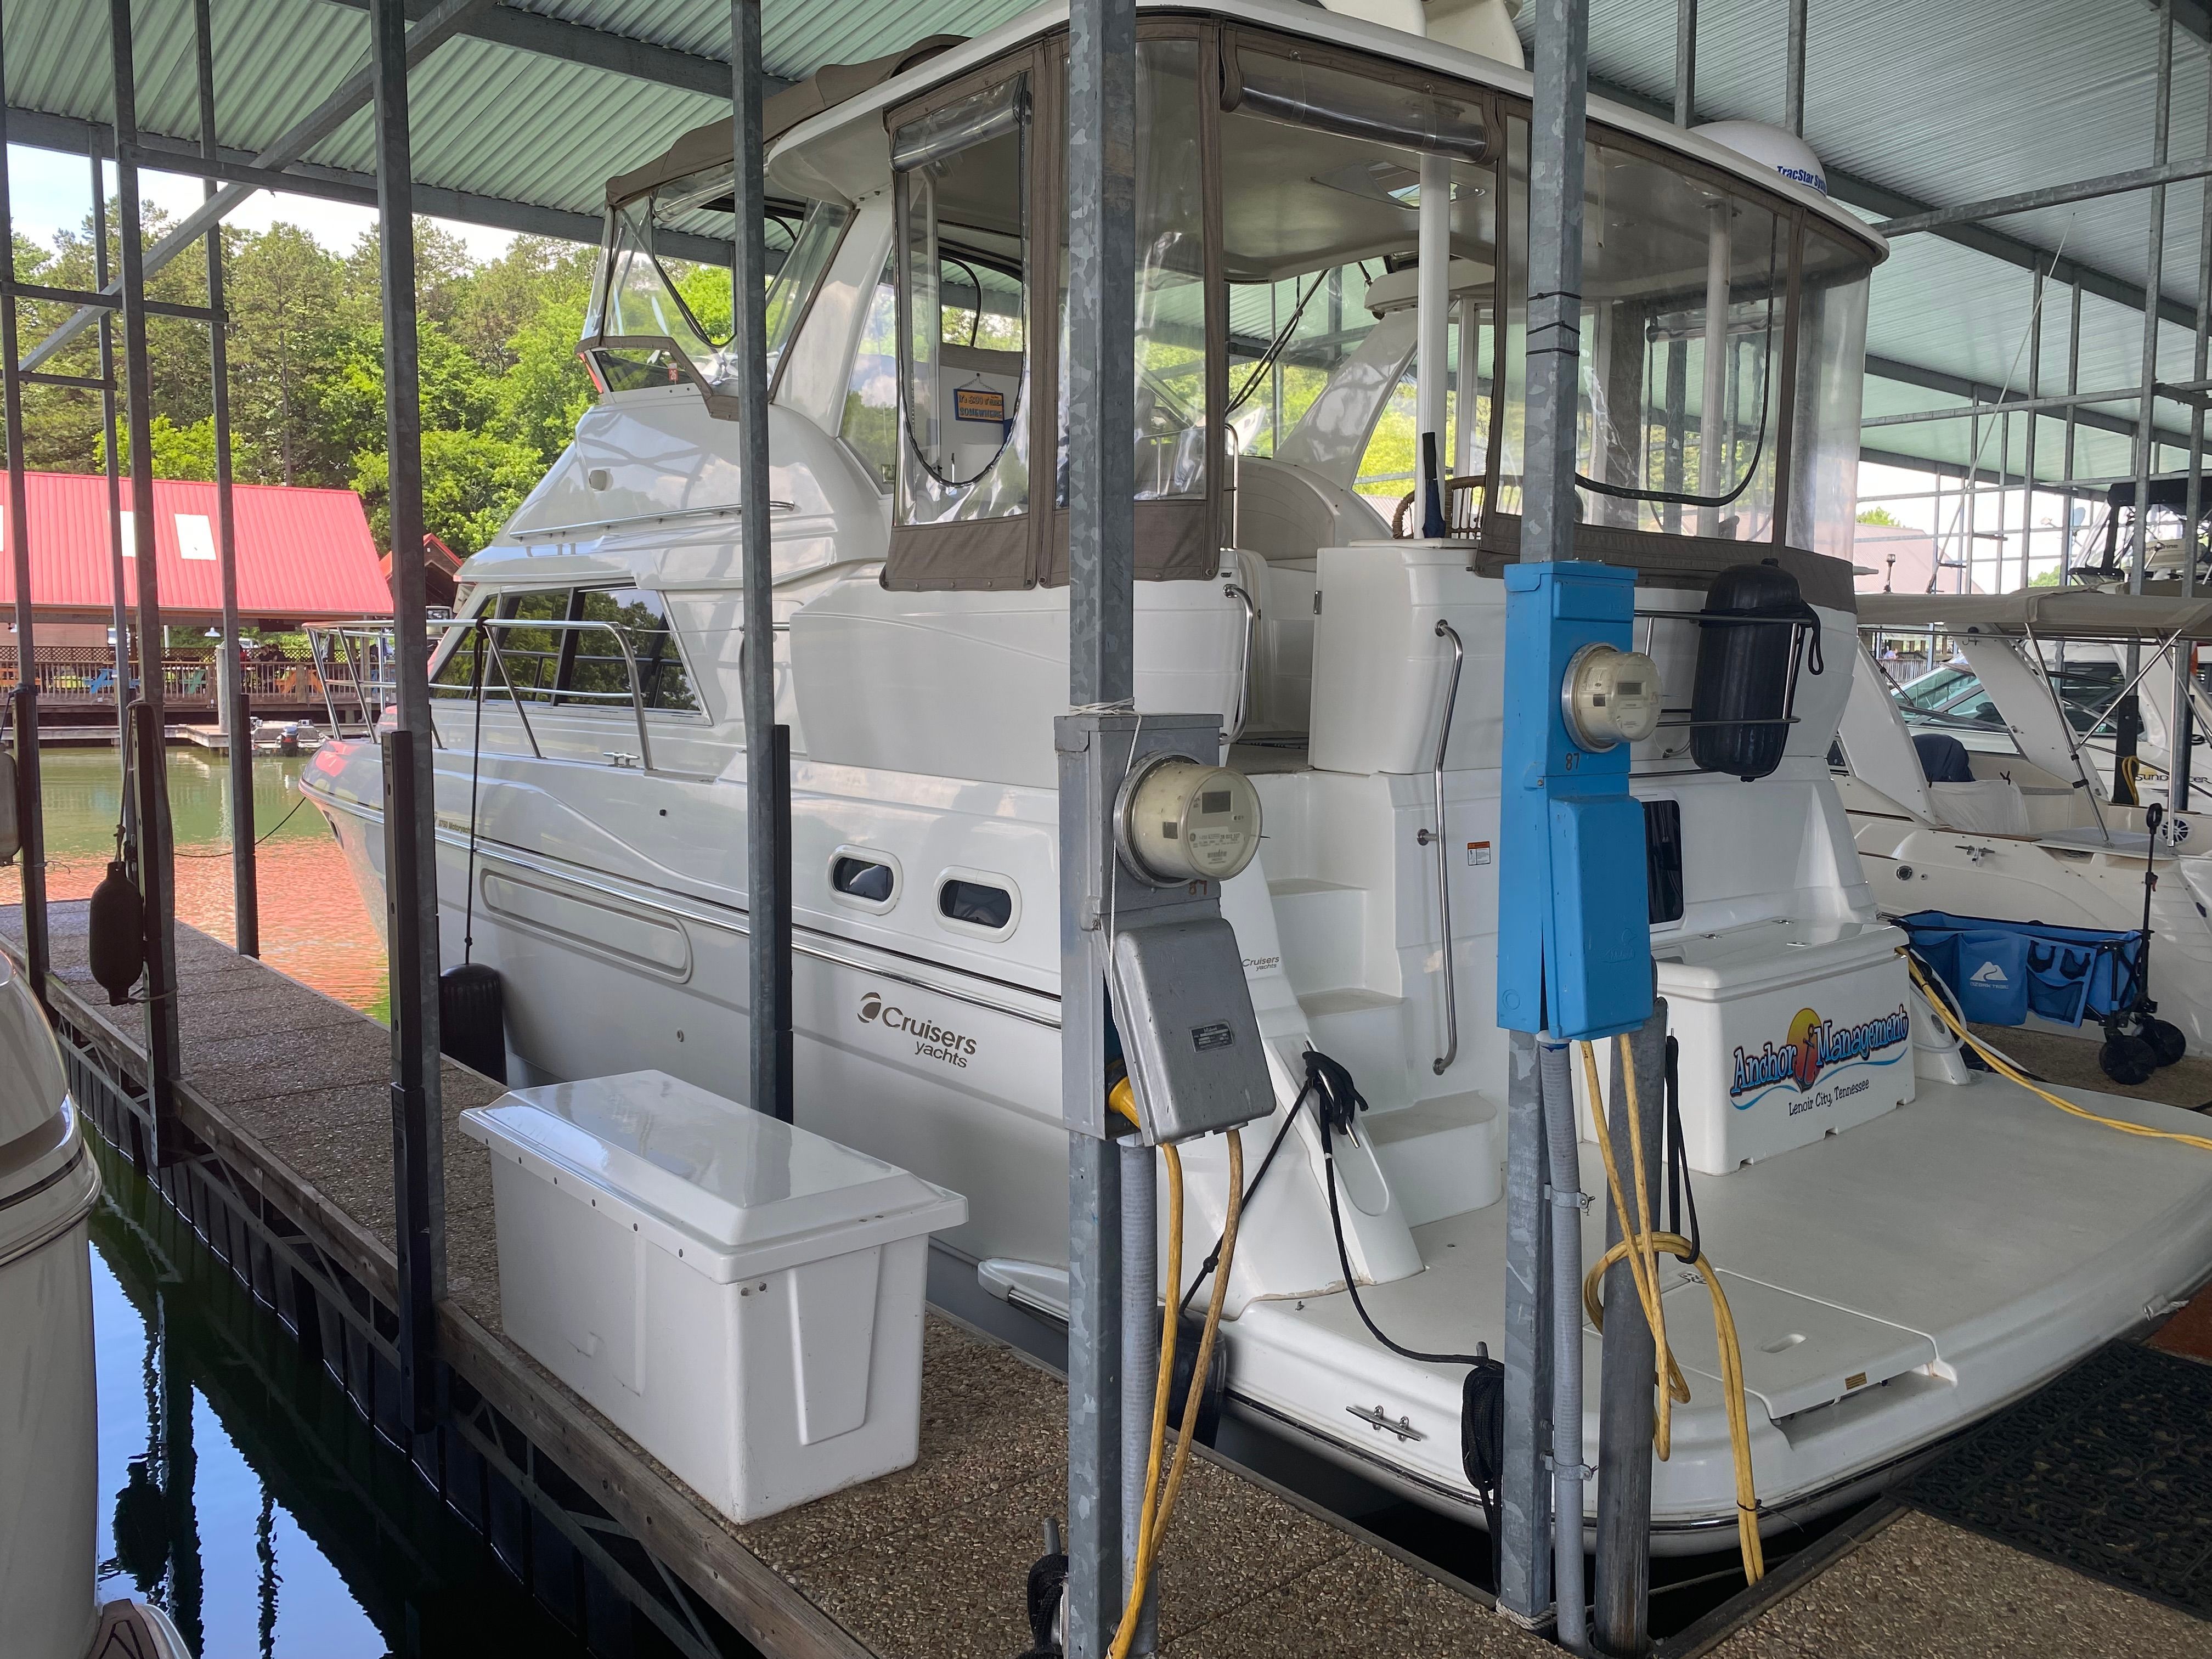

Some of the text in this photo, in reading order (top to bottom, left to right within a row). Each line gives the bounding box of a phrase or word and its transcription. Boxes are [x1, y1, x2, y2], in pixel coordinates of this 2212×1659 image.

[1777, 166, 1813, 184] TracStar
[968, 394, 984, 405] 5:00
[960, 407, 1002, 419] SOMEWHERE
[1566, 752, 1580, 771] 87
[449, 821, 472, 834] Motoryach
[1242, 956, 1279, 967] Cruisers
[1256, 963, 1277, 972] yachts
[882, 1007, 977, 1056] Cruisers
[915, 1041, 968, 1068] yachts
[1729, 1002, 1909, 1098] Anchor Management
[1788, 1079, 1869, 1116] Lenoir City, Tennessee
